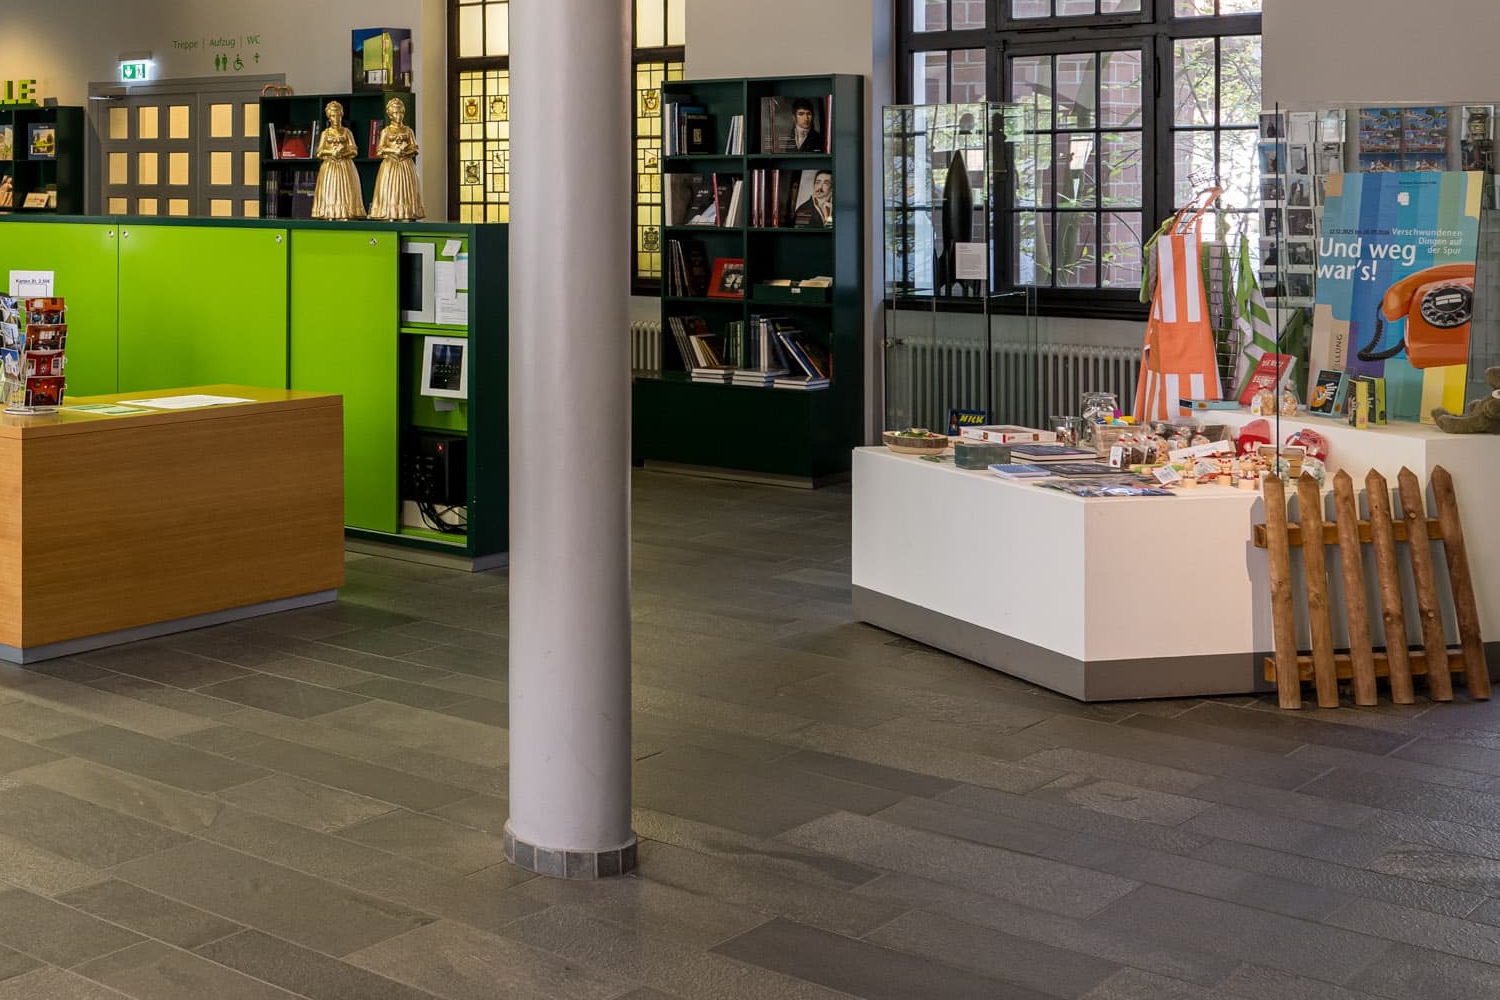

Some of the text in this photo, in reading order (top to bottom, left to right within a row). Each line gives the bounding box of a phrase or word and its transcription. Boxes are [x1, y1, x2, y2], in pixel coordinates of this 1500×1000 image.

[210, 37, 236, 49] Aufzug
[246, 34, 261, 45] WC
[1391, 227, 1463, 237] Verschwundenen
[1418, 237, 1463, 247] Dingen auf
[1319, 237, 1416, 266] Und weg
[1427, 246, 1461, 256] der Spur
[1316, 260, 1378, 281] war's!
